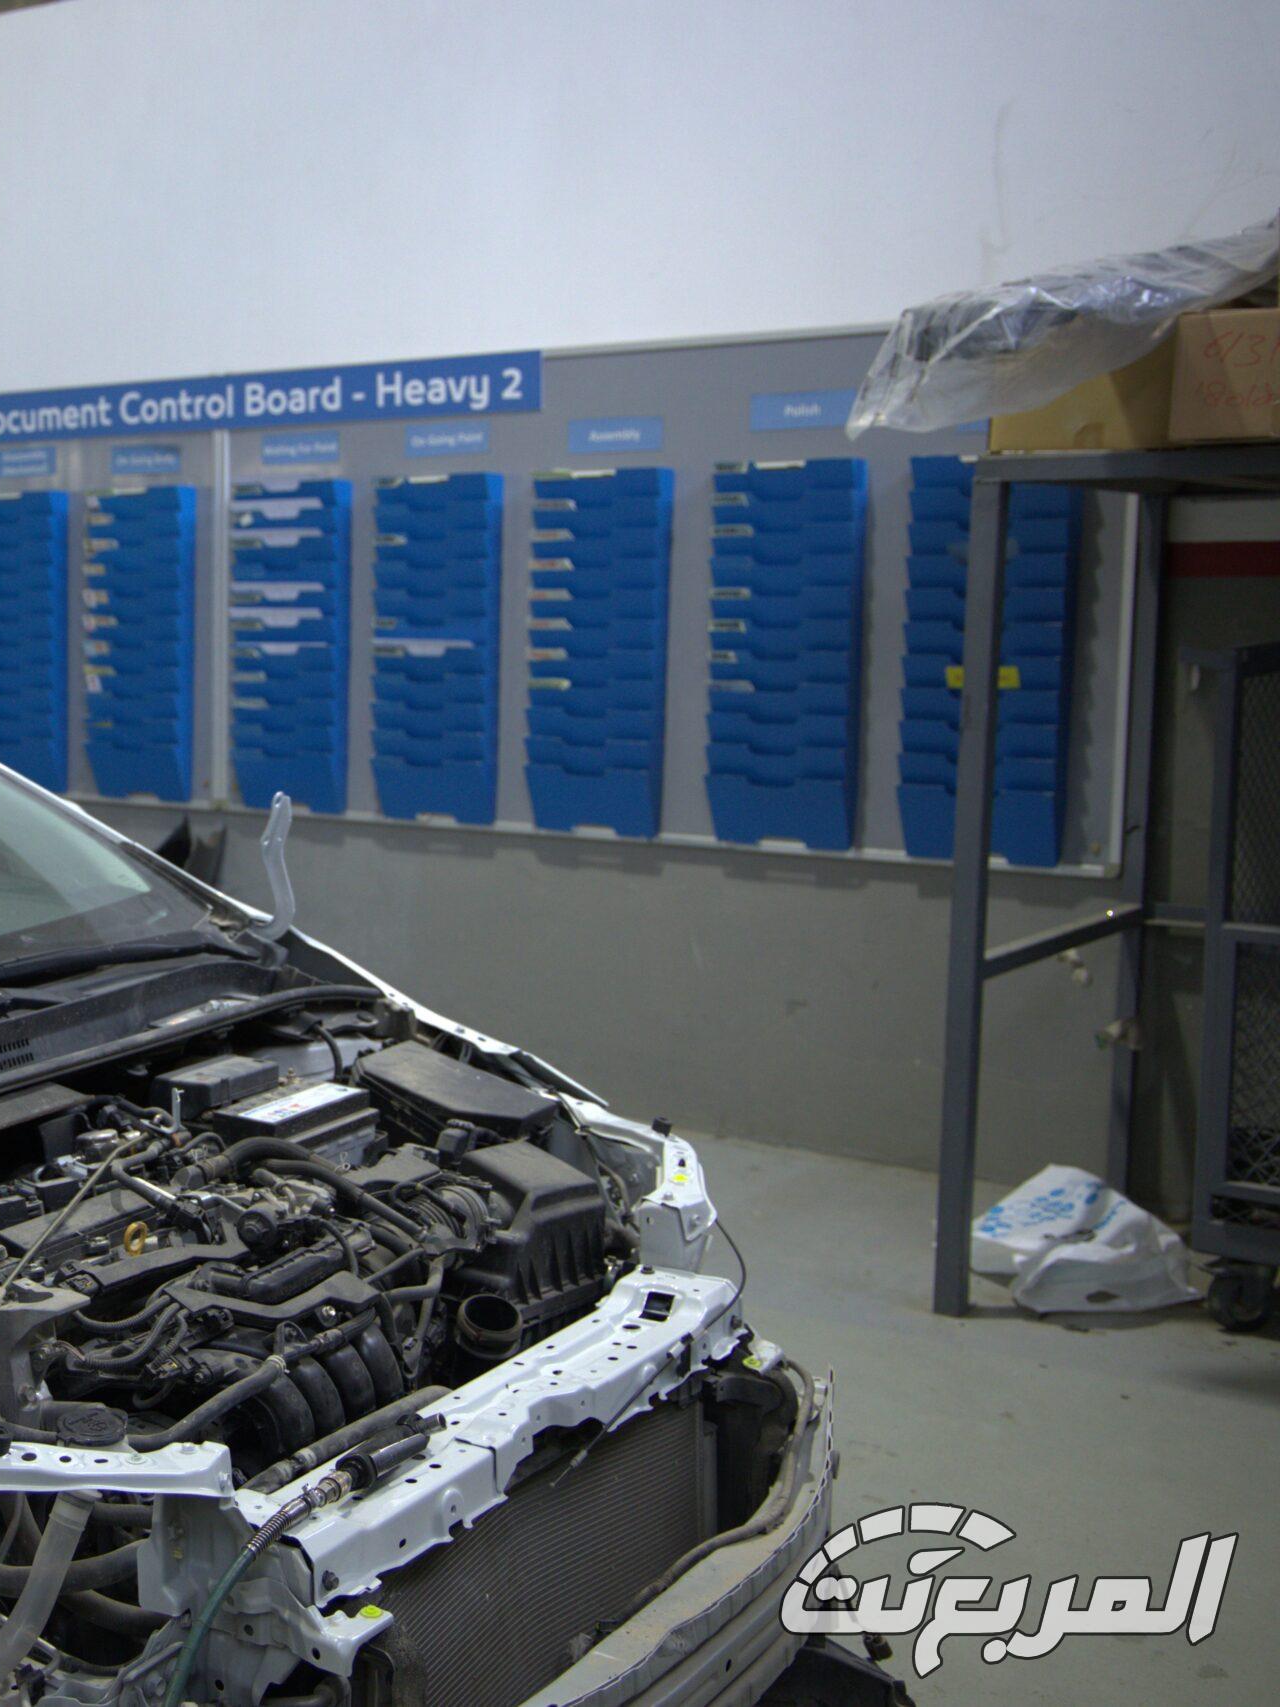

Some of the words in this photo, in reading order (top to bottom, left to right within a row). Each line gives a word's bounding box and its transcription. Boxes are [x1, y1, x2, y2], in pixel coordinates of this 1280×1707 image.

[119, 384, 235, 426] Control
[243, 375, 342, 417] Board
[375, 370, 490, 411] Heavy
[501, 367, 524, 400] 2
